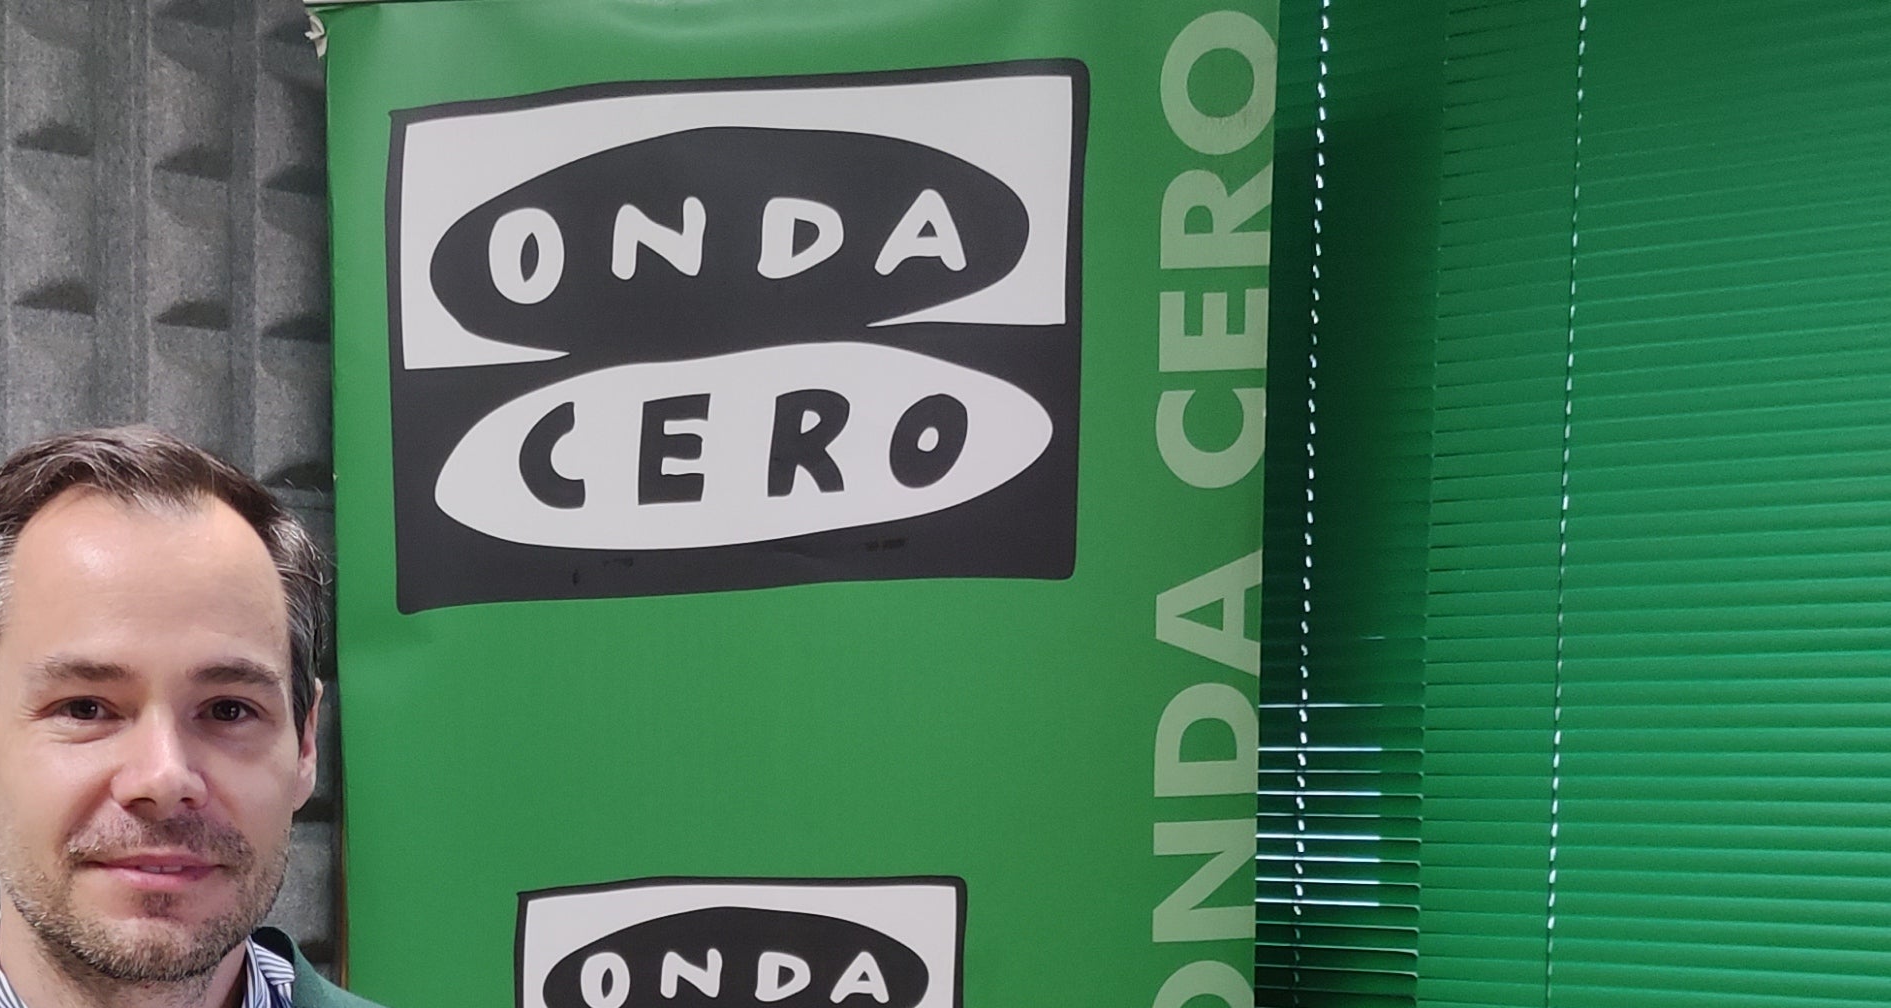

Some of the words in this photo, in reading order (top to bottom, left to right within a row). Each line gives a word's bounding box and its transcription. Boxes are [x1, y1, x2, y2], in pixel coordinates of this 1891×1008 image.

[488, 188, 967, 304] ONDA
[1155, 9, 1278, 489] CERO
[519, 388, 968, 510] CERO
